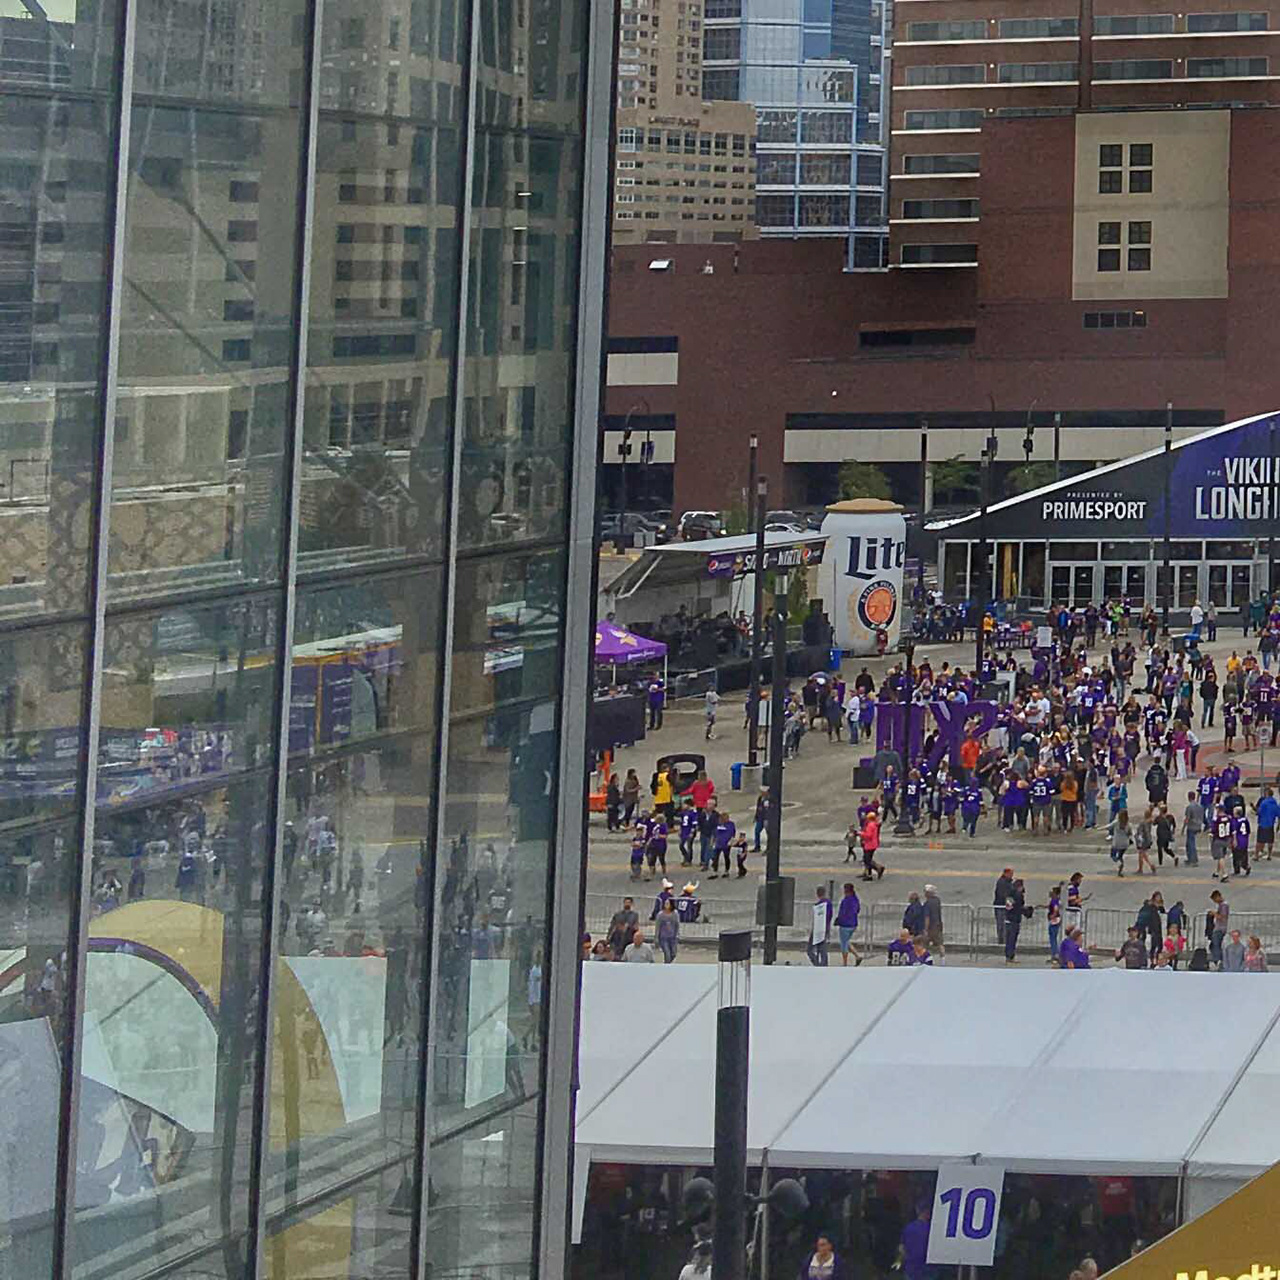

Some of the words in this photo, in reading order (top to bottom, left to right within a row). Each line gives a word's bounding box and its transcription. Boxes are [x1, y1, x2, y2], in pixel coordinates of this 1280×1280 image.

[1043, 501, 1147, 520] PRIMESPORT
[844, 536, 904, 580] Lite
[1034, 787, 1046, 796] 33
[1240, 822, 1247, 835] 4
[939, 1187, 997, 1240] 10
